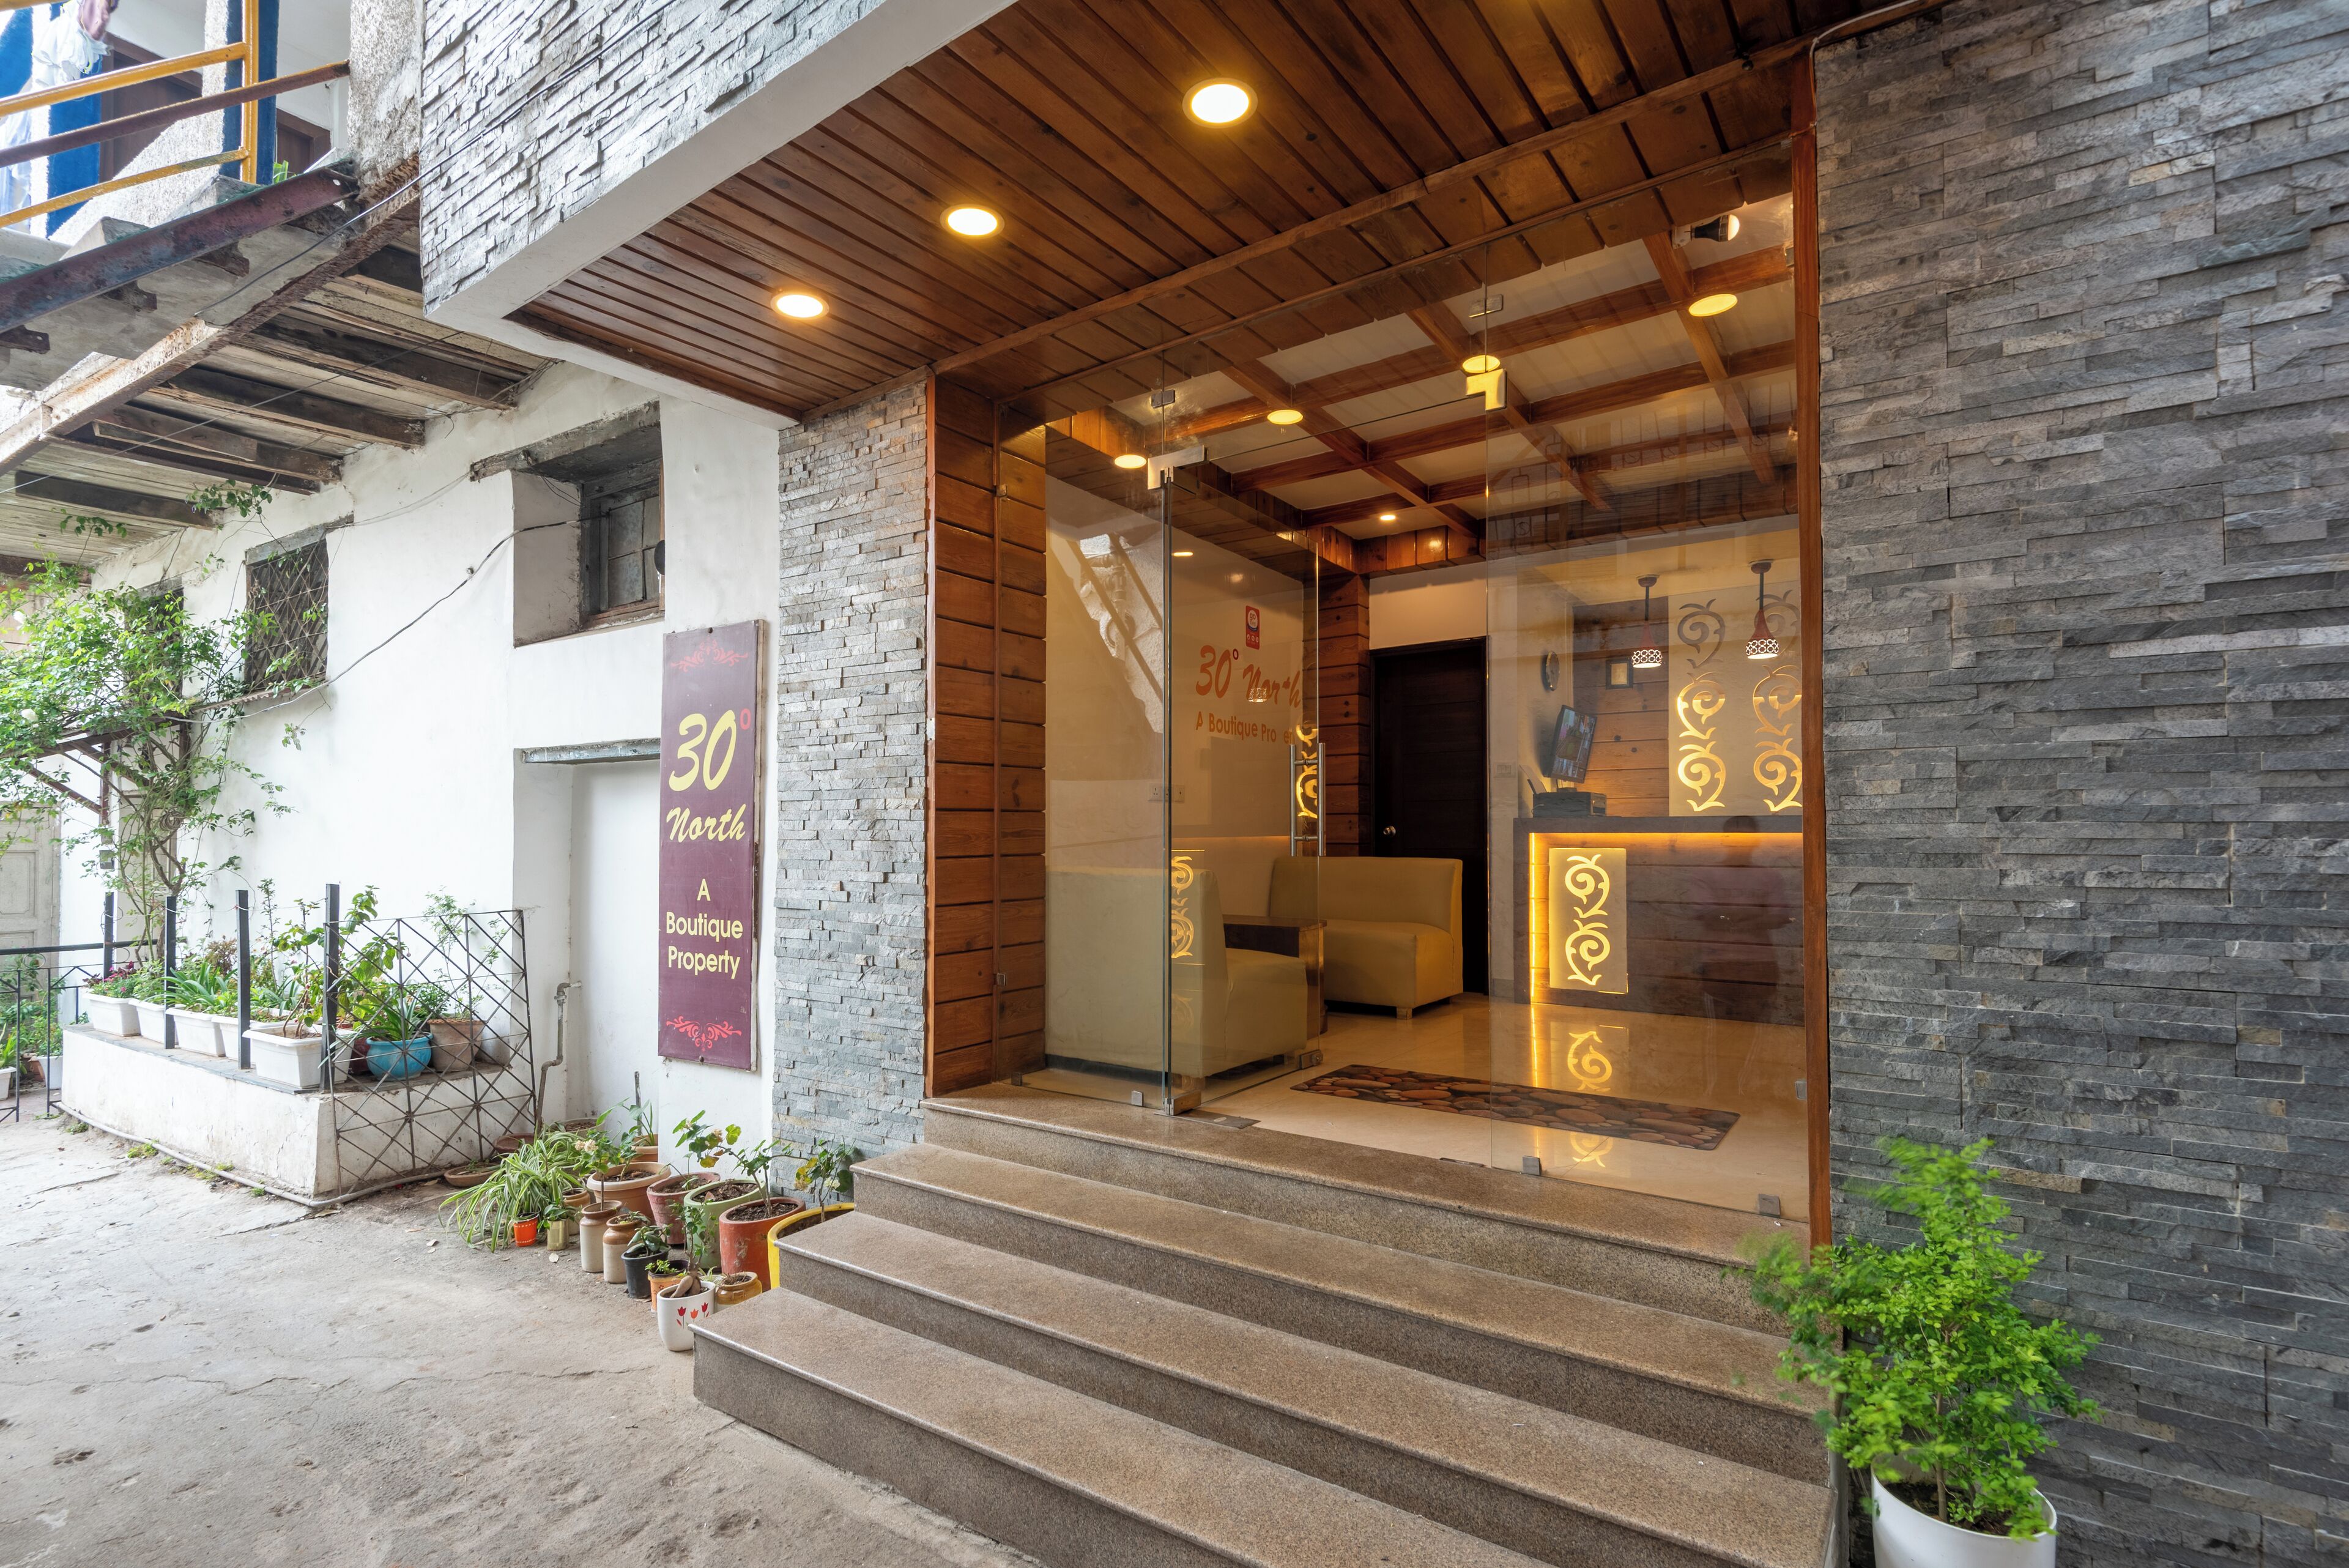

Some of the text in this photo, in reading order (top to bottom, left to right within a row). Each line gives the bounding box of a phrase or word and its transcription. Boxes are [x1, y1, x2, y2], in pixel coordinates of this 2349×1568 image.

[1242, 663, 1301, 708] North
[1195, 711, 1204, 730] A
[1209, 713, 1258, 740] Boutique
[666, 803, 747, 842] North
[697, 878, 711, 901] A
[666, 911, 743, 942] Boutique
[667, 945, 741, 979] Property
